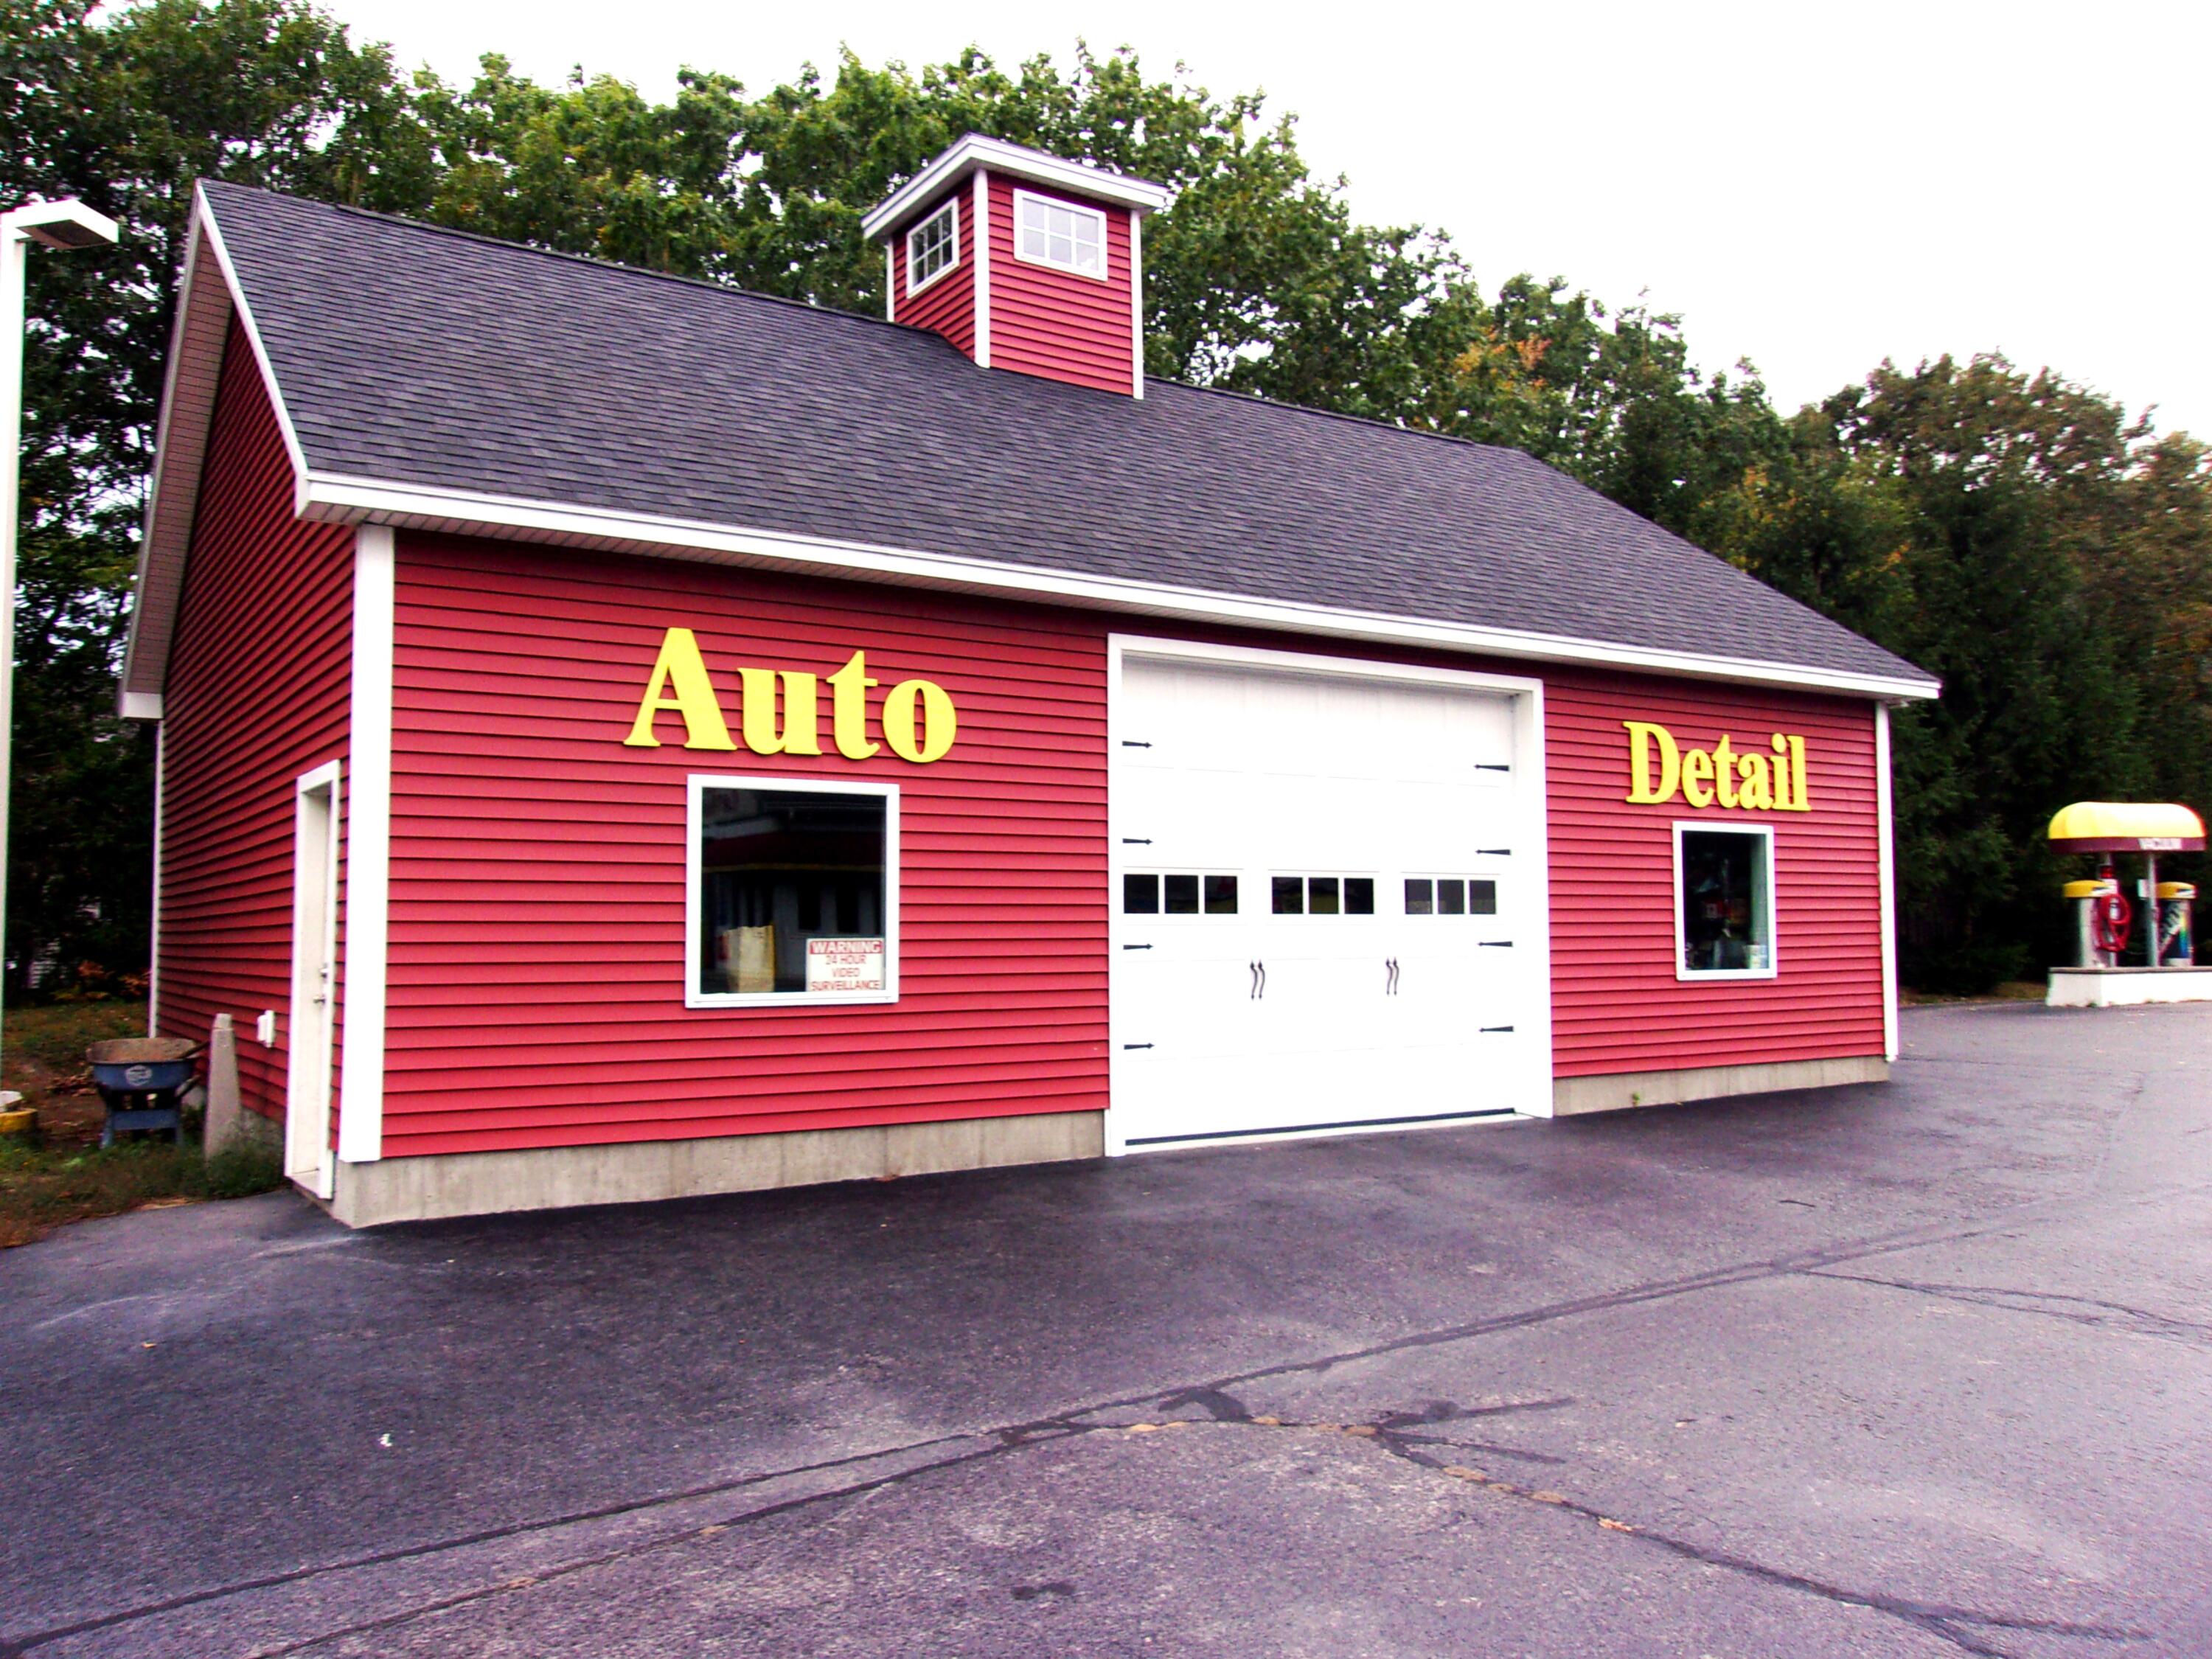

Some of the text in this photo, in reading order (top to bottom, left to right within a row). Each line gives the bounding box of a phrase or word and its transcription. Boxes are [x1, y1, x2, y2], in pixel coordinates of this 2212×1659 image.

[623, 627, 956, 763] Auto
[1622, 720, 1812, 812] Detail
[812, 941, 881, 953] WARNING
[826, 955, 866, 964] 24 HOUR
[832, 967, 860, 977] VIDEO
[811, 980, 880, 991] SURVEILLANCE
